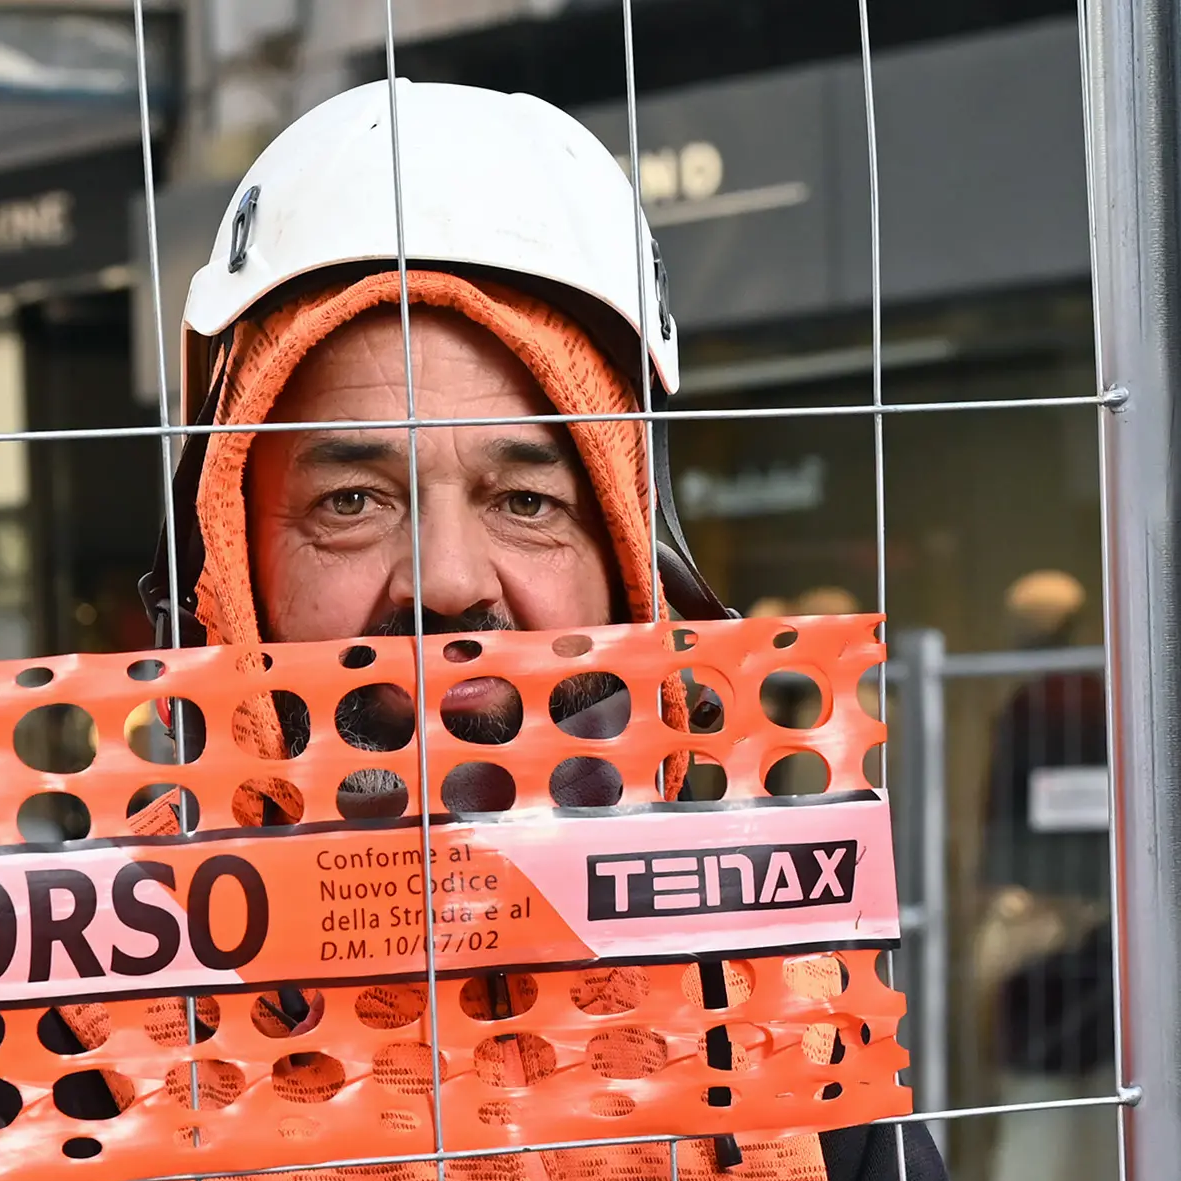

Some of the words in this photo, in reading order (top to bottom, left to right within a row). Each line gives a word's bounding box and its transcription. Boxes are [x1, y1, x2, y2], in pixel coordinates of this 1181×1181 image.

[316, 847, 437, 871] Conforme
[448, 843, 471, 863] al
[320, 873, 398, 901] Nuovo
[595, 848, 847, 912] TENAX
[321, 907, 380, 932] della
[484, 905, 498, 920] e
[509, 896, 531, 919] al
[320, 938, 375, 961] D.M.
